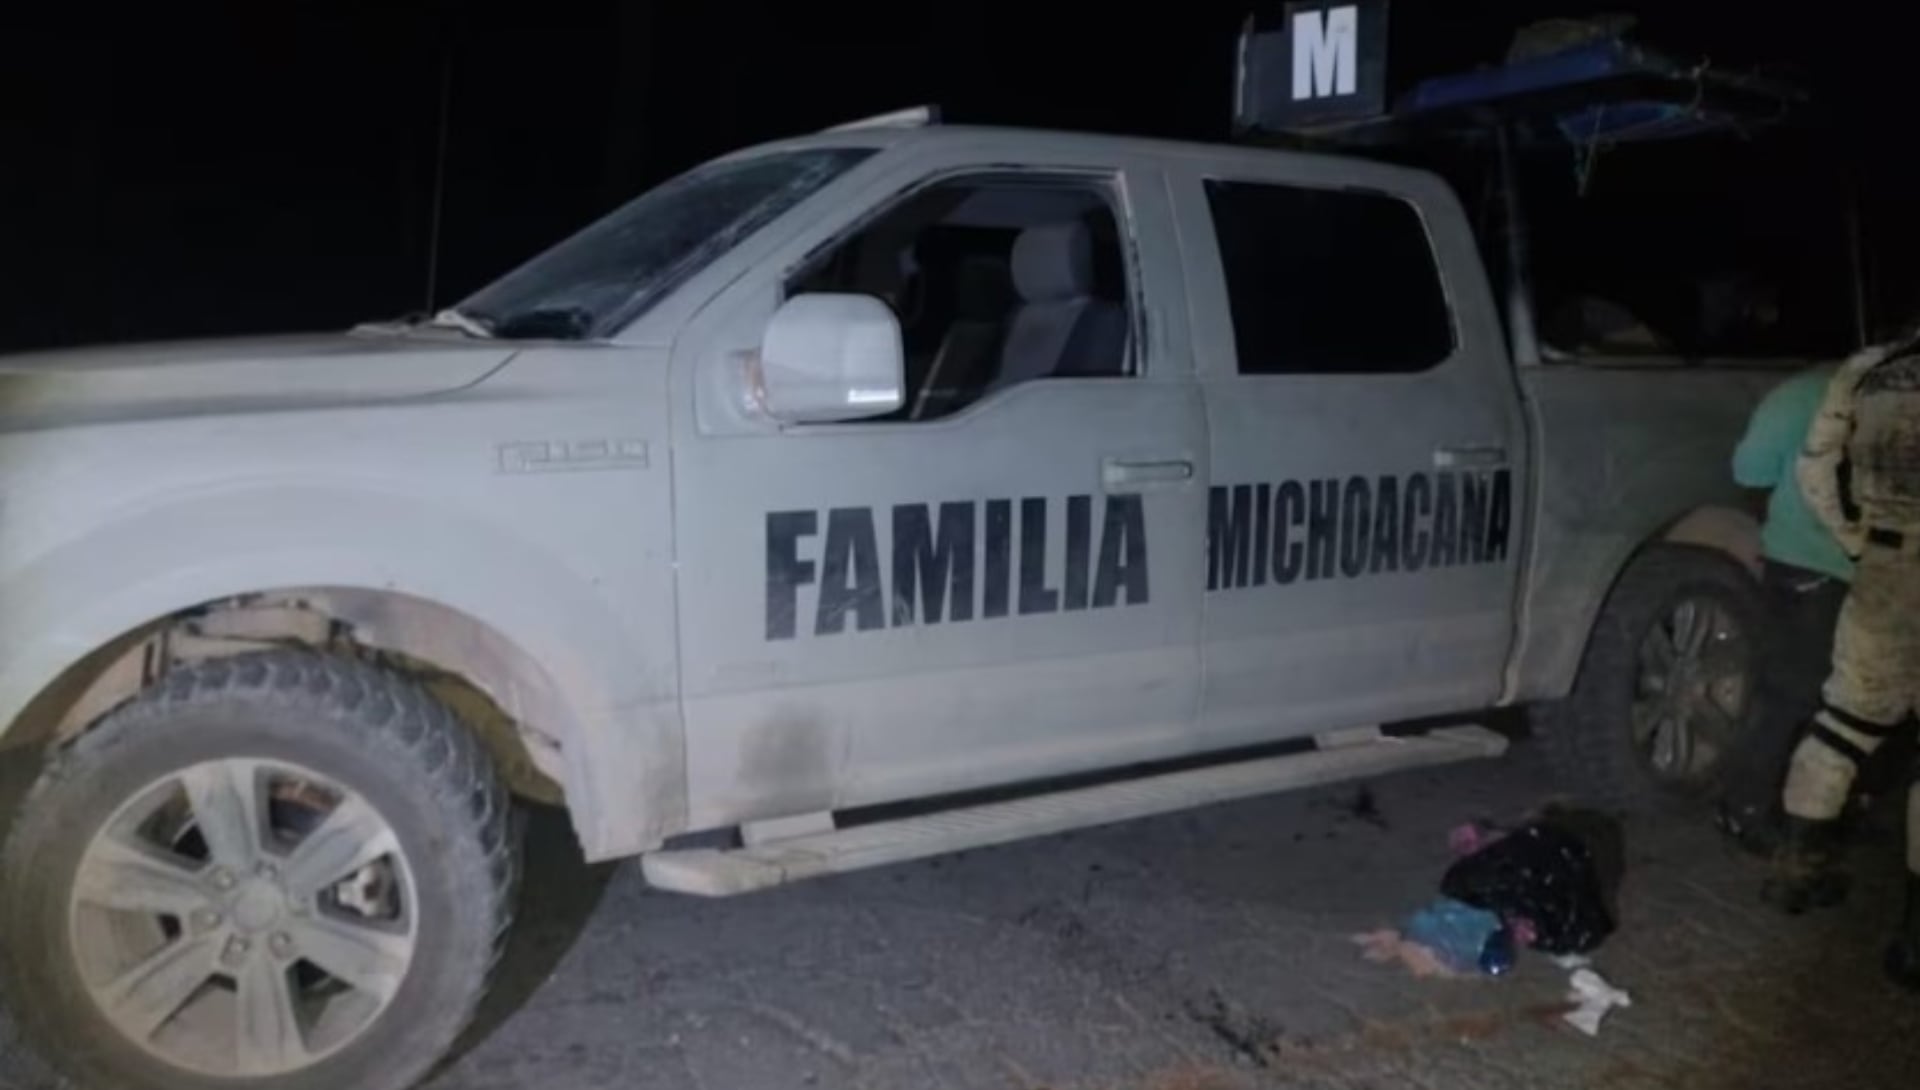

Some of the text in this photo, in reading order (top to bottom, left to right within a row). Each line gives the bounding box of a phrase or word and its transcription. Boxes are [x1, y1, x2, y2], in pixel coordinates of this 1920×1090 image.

[1292, 5, 1358, 99] M
[765, 468, 1511, 641] FAMILIA MICHOACANA
